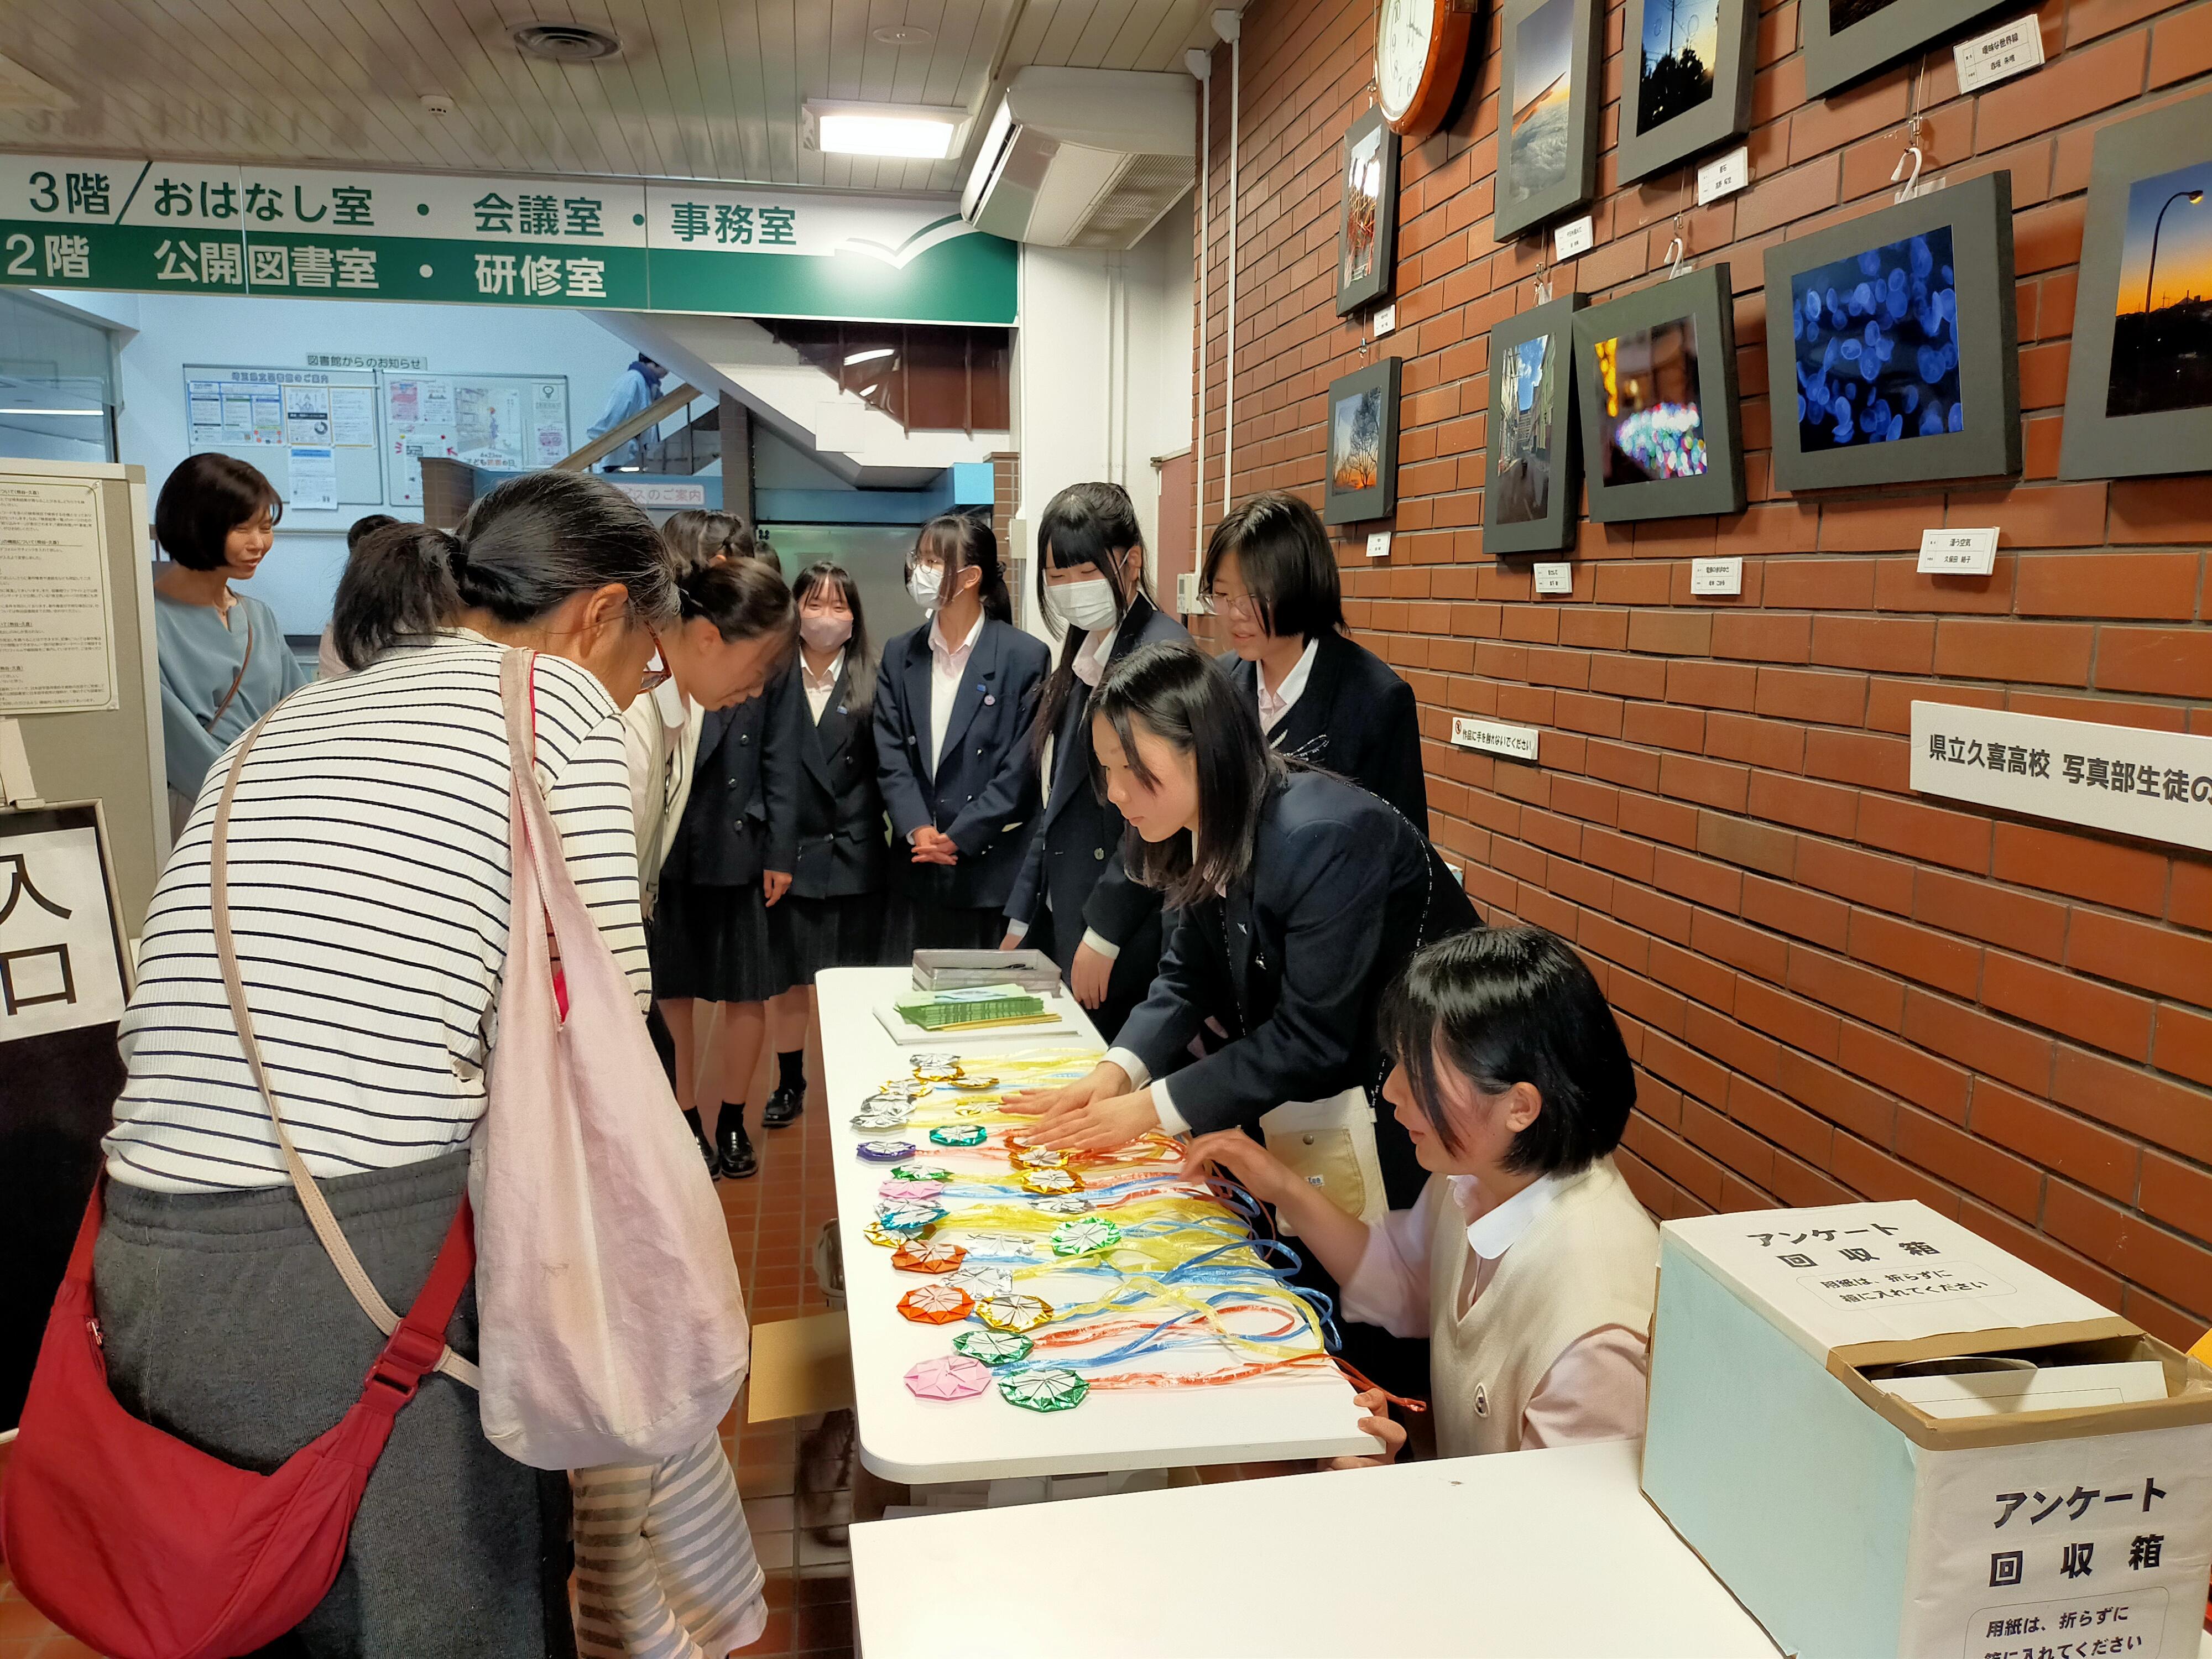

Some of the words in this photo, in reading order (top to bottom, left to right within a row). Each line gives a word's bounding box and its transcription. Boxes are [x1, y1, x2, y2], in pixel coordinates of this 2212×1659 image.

[29, 171, 111, 216] 3階
[154, 178, 374, 226] おはなし室
[473, 192, 604, 236] 会議室
[671, 201, 796, 245] 事務室
[6, 234, 90, 279] 2階
[154, 238, 379, 289] 公開図書室
[474, 253, 607, 298] 研修室
[307, 355, 420, 369] 図書館からのお知らせ
[1463, 729, 1531, 751] 作品に手を触れないでください
[1929, 734, 2050, 779] 県立久喜高校
[2062, 754, 2212, 805] 写真部生徒の
[0, 853, 76, 1016] 入口
[1746, 1223, 1899, 1246] アンケート
[1820, 1270, 1953, 1289] 用紙は、折らずに
[1839, 1280, 1989, 1303] 箱に入れてください
[1993, 1477, 2168, 1528] アンケート
[1986, 1606, 2129, 1638] 用紙は、折らずに
